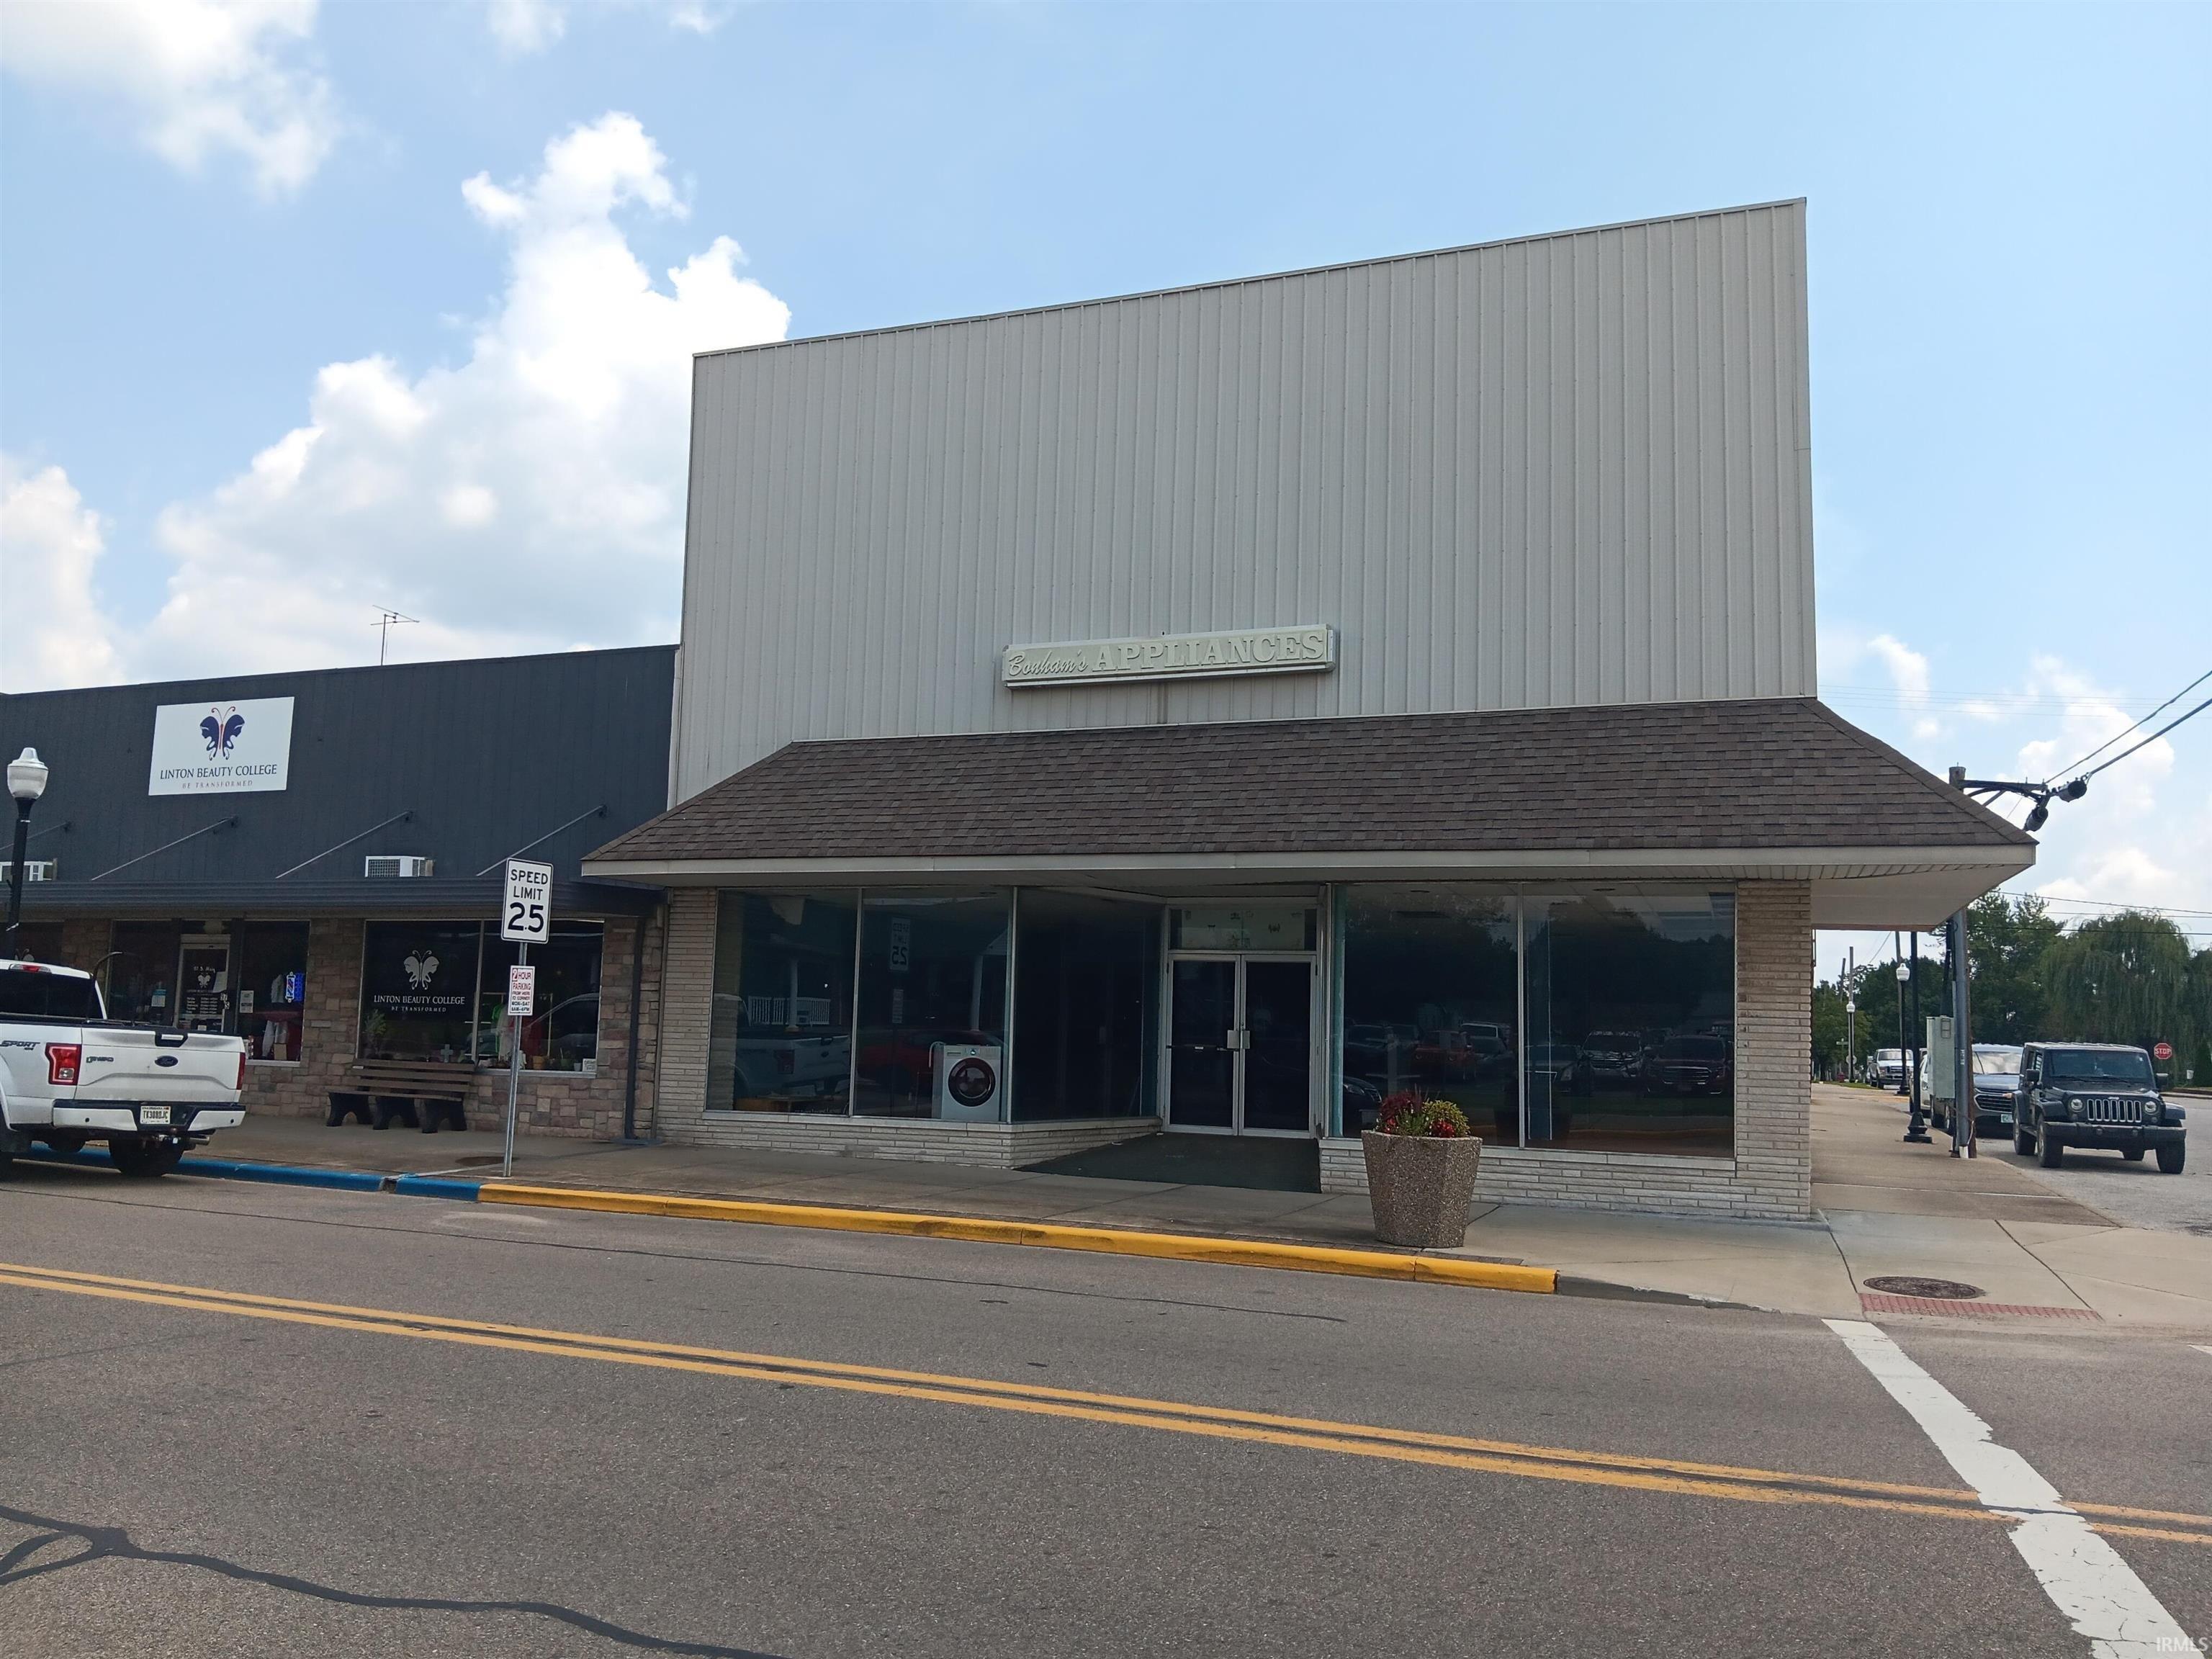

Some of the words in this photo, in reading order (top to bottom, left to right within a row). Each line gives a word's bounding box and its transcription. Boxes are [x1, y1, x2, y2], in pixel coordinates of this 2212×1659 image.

[1008, 649, 1088, 676] Bonham's
[1092, 633, 1324, 673] APPLIANCES
[160, 768, 194, 779] LINTON
[197, 767, 233, 778] BEAUTY
[235, 764, 277, 776] COLLEGE
[196, 780, 253, 788] TRANSFORMED
[511, 869, 548, 884] SPEED
[513, 886, 543, 900] LIMIT
[508, 902, 544, 932] 25
[513, 968, 518, 980] 2
[403, 995, 431, 1004] BEAUTY
[432, 996, 465, 1004] COLLEGE
